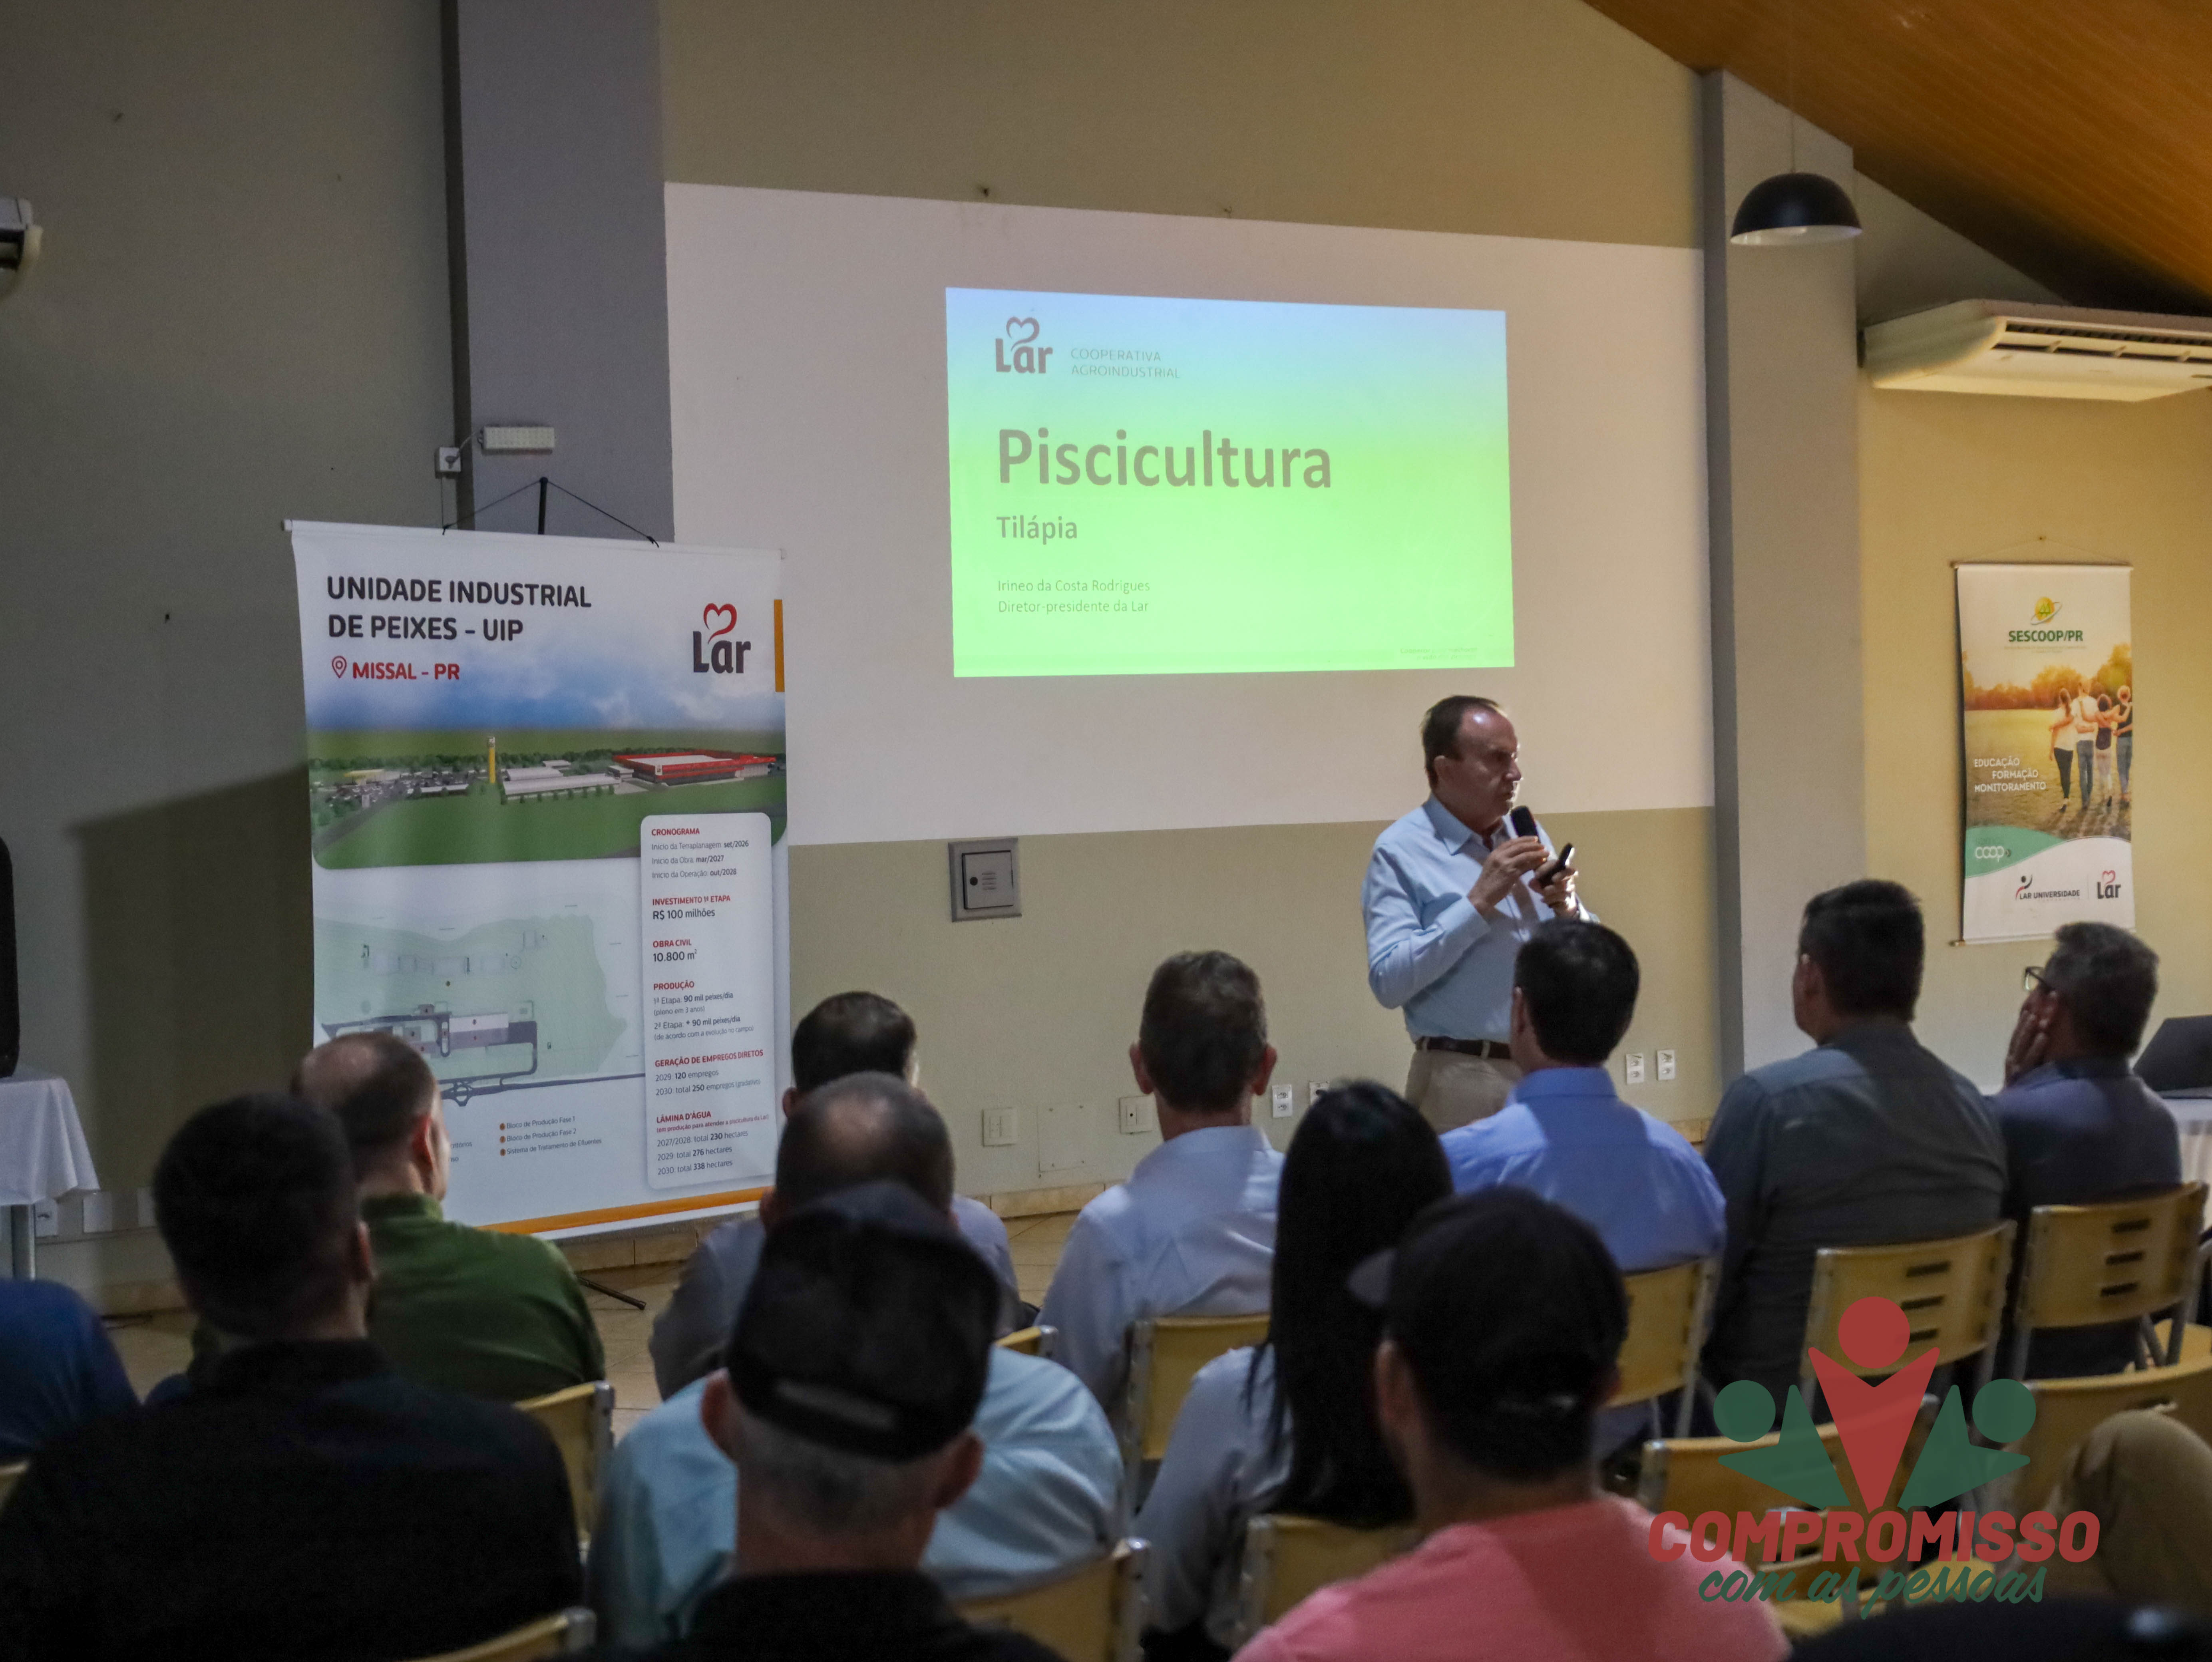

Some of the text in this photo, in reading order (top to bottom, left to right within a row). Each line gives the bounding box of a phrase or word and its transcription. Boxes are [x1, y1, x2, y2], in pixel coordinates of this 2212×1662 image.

[995, 338, 1053, 374] Lar
[1071, 348, 1161, 362] COOPERATIVA
[1072, 364, 1180, 378] AGROINDUSTRIAL
[999, 427, 1331, 489] Piscicultura
[997, 514, 1078, 546] Tilápia
[327, 576, 591, 608] UNIDADE INDUSTRIAL
[998, 579, 1150, 594] Irineo da Costa Rodrigues
[999, 599, 1148, 614] Diretor-presidente da Lar
[328, 614, 365, 638] DE
[370, 615, 457, 640] PEIXES
[483, 618, 523, 641] UIP
[2008, 630, 2083, 642] SESCOOP/PR
[693, 630, 751, 674] Lar
[352, 661, 416, 680] MISSAL
[435, 662, 460, 680] PR
[1974, 755, 2020, 768] EDUCAÇÃO
[1992, 768, 2038, 780] FORMAÇÃO
[1975, 781, 2046, 792] MONITORAMENTO
[696, 855, 724, 864] mar/2027
[2033, 890, 2080, 899] UNIVERSIDADE
[2097, 881, 2121, 899] Lar
[652, 896, 702, 905] INVESTIMENTO
[653, 909, 715, 920] R$ 100 milhões
[653, 951, 685, 962] 10.800
[653, 980, 694, 990] PRODUÇÃO
[705, 992, 734, 1002] peixes/dia
[713, 1016, 741, 1025] peixes/dia
[706, 1028, 727, 1036] evolução
[655, 1057, 690, 1068] GERAÇÃO
[702, 1052, 737, 1063] EMPREGOS
[738, 1049, 764, 1059] DIRETOS
[688, 1070, 719, 1078] empregos
[706, 1081, 734, 1090] empregos
[656, 1111, 712, 1123] LÂMINA D'ÁGUA
[724, 1130, 748, 1139] hectares
[676, 1151, 691, 1159] total
[705, 1146, 732, 1155] hectares
[677, 1164, 692, 1173] total
[706, 1159, 733, 1169] hectares
